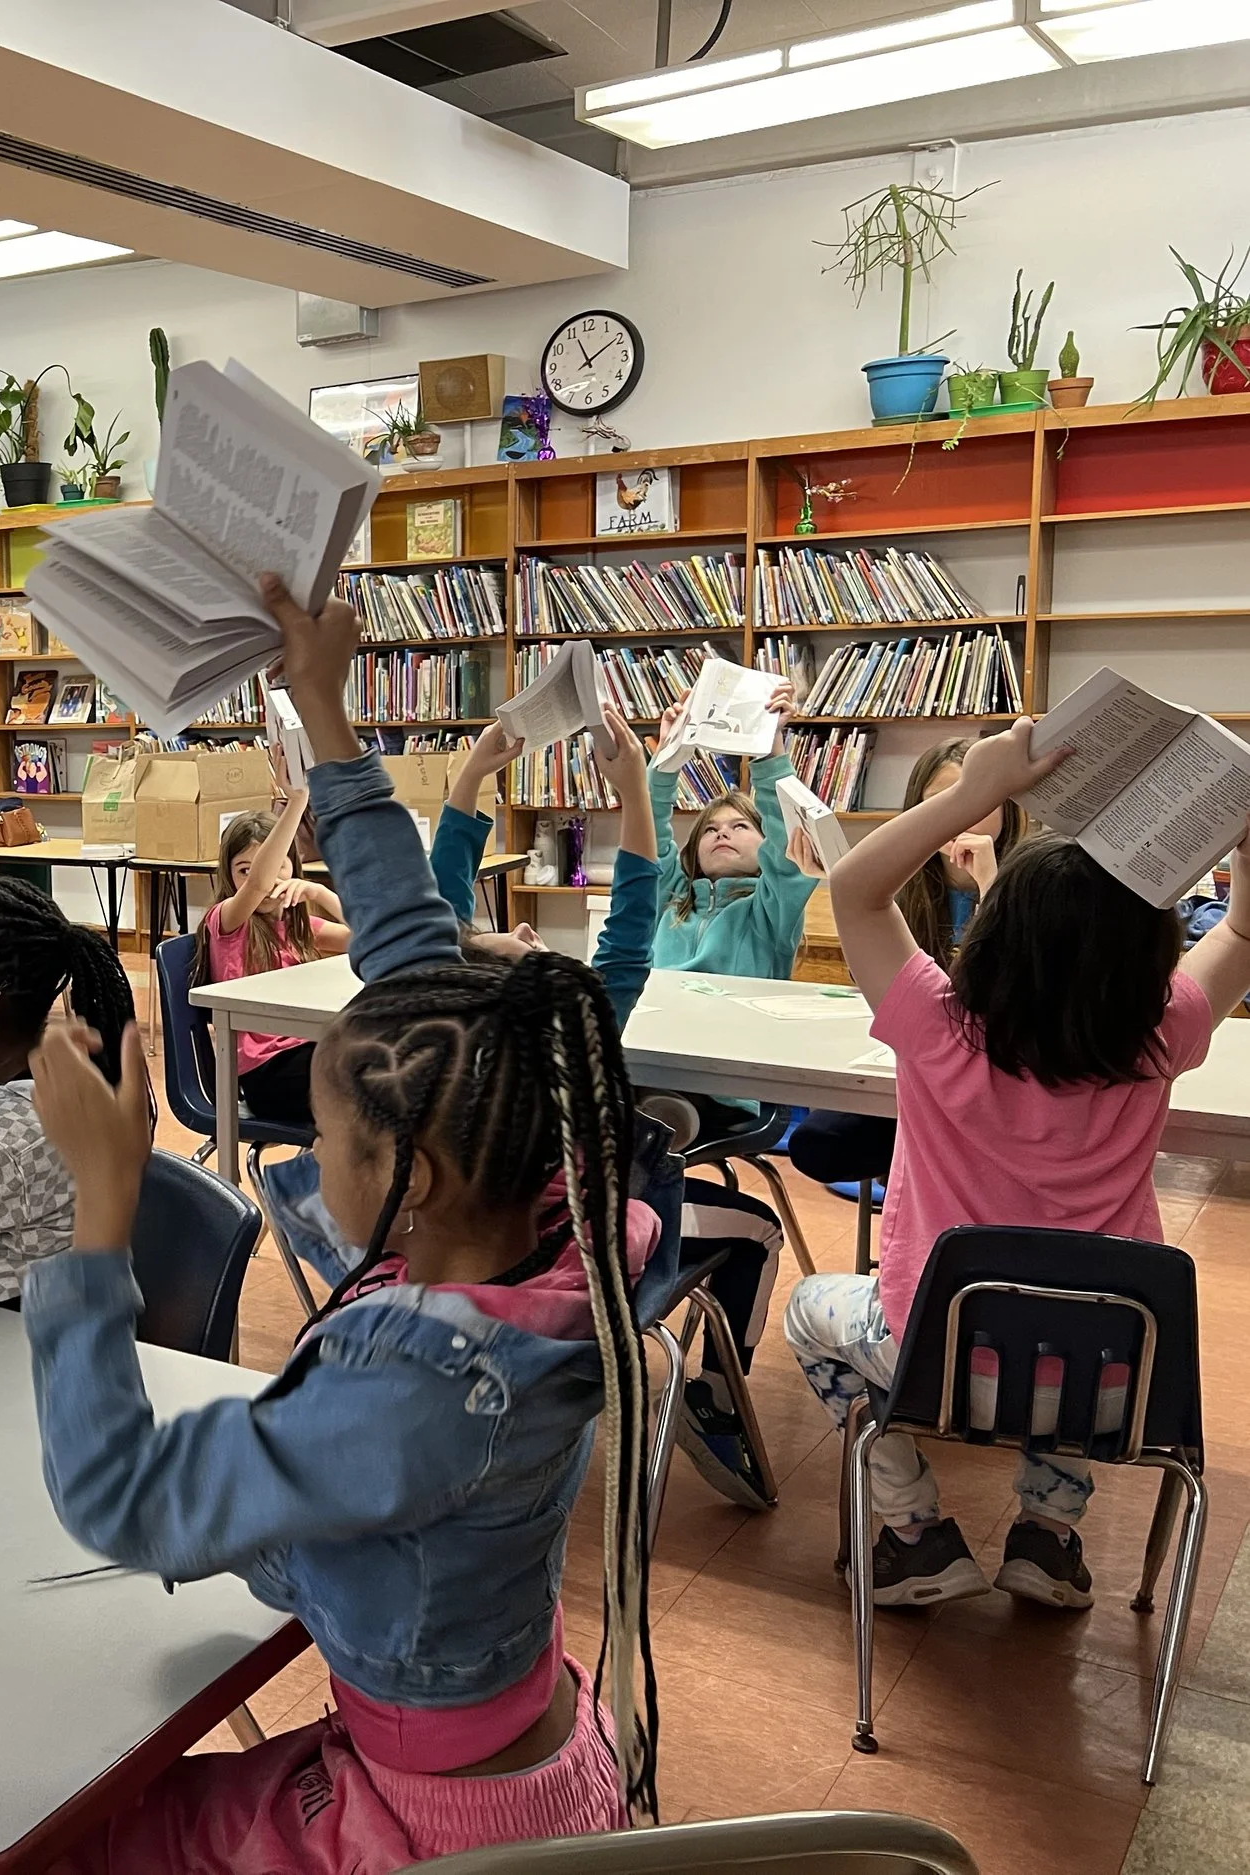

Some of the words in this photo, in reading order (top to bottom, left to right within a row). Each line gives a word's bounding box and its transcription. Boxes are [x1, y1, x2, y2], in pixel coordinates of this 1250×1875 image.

[582, 319, 595, 332] 12
[604, 321, 609, 333] 1
[567, 328, 577, 340] 11
[616, 332, 625, 345] 2
[553, 343, 564, 357] 10
[621, 350, 629, 363] 3
[549, 363, 557, 375] 9
[615, 369, 623, 381] 4
[553, 379, 562, 391] 8
[568, 391, 575, 404] 7
[584, 392, 593, 405] 6
[602, 386, 609, 398] 5
[609, 512, 651, 530] FARM
